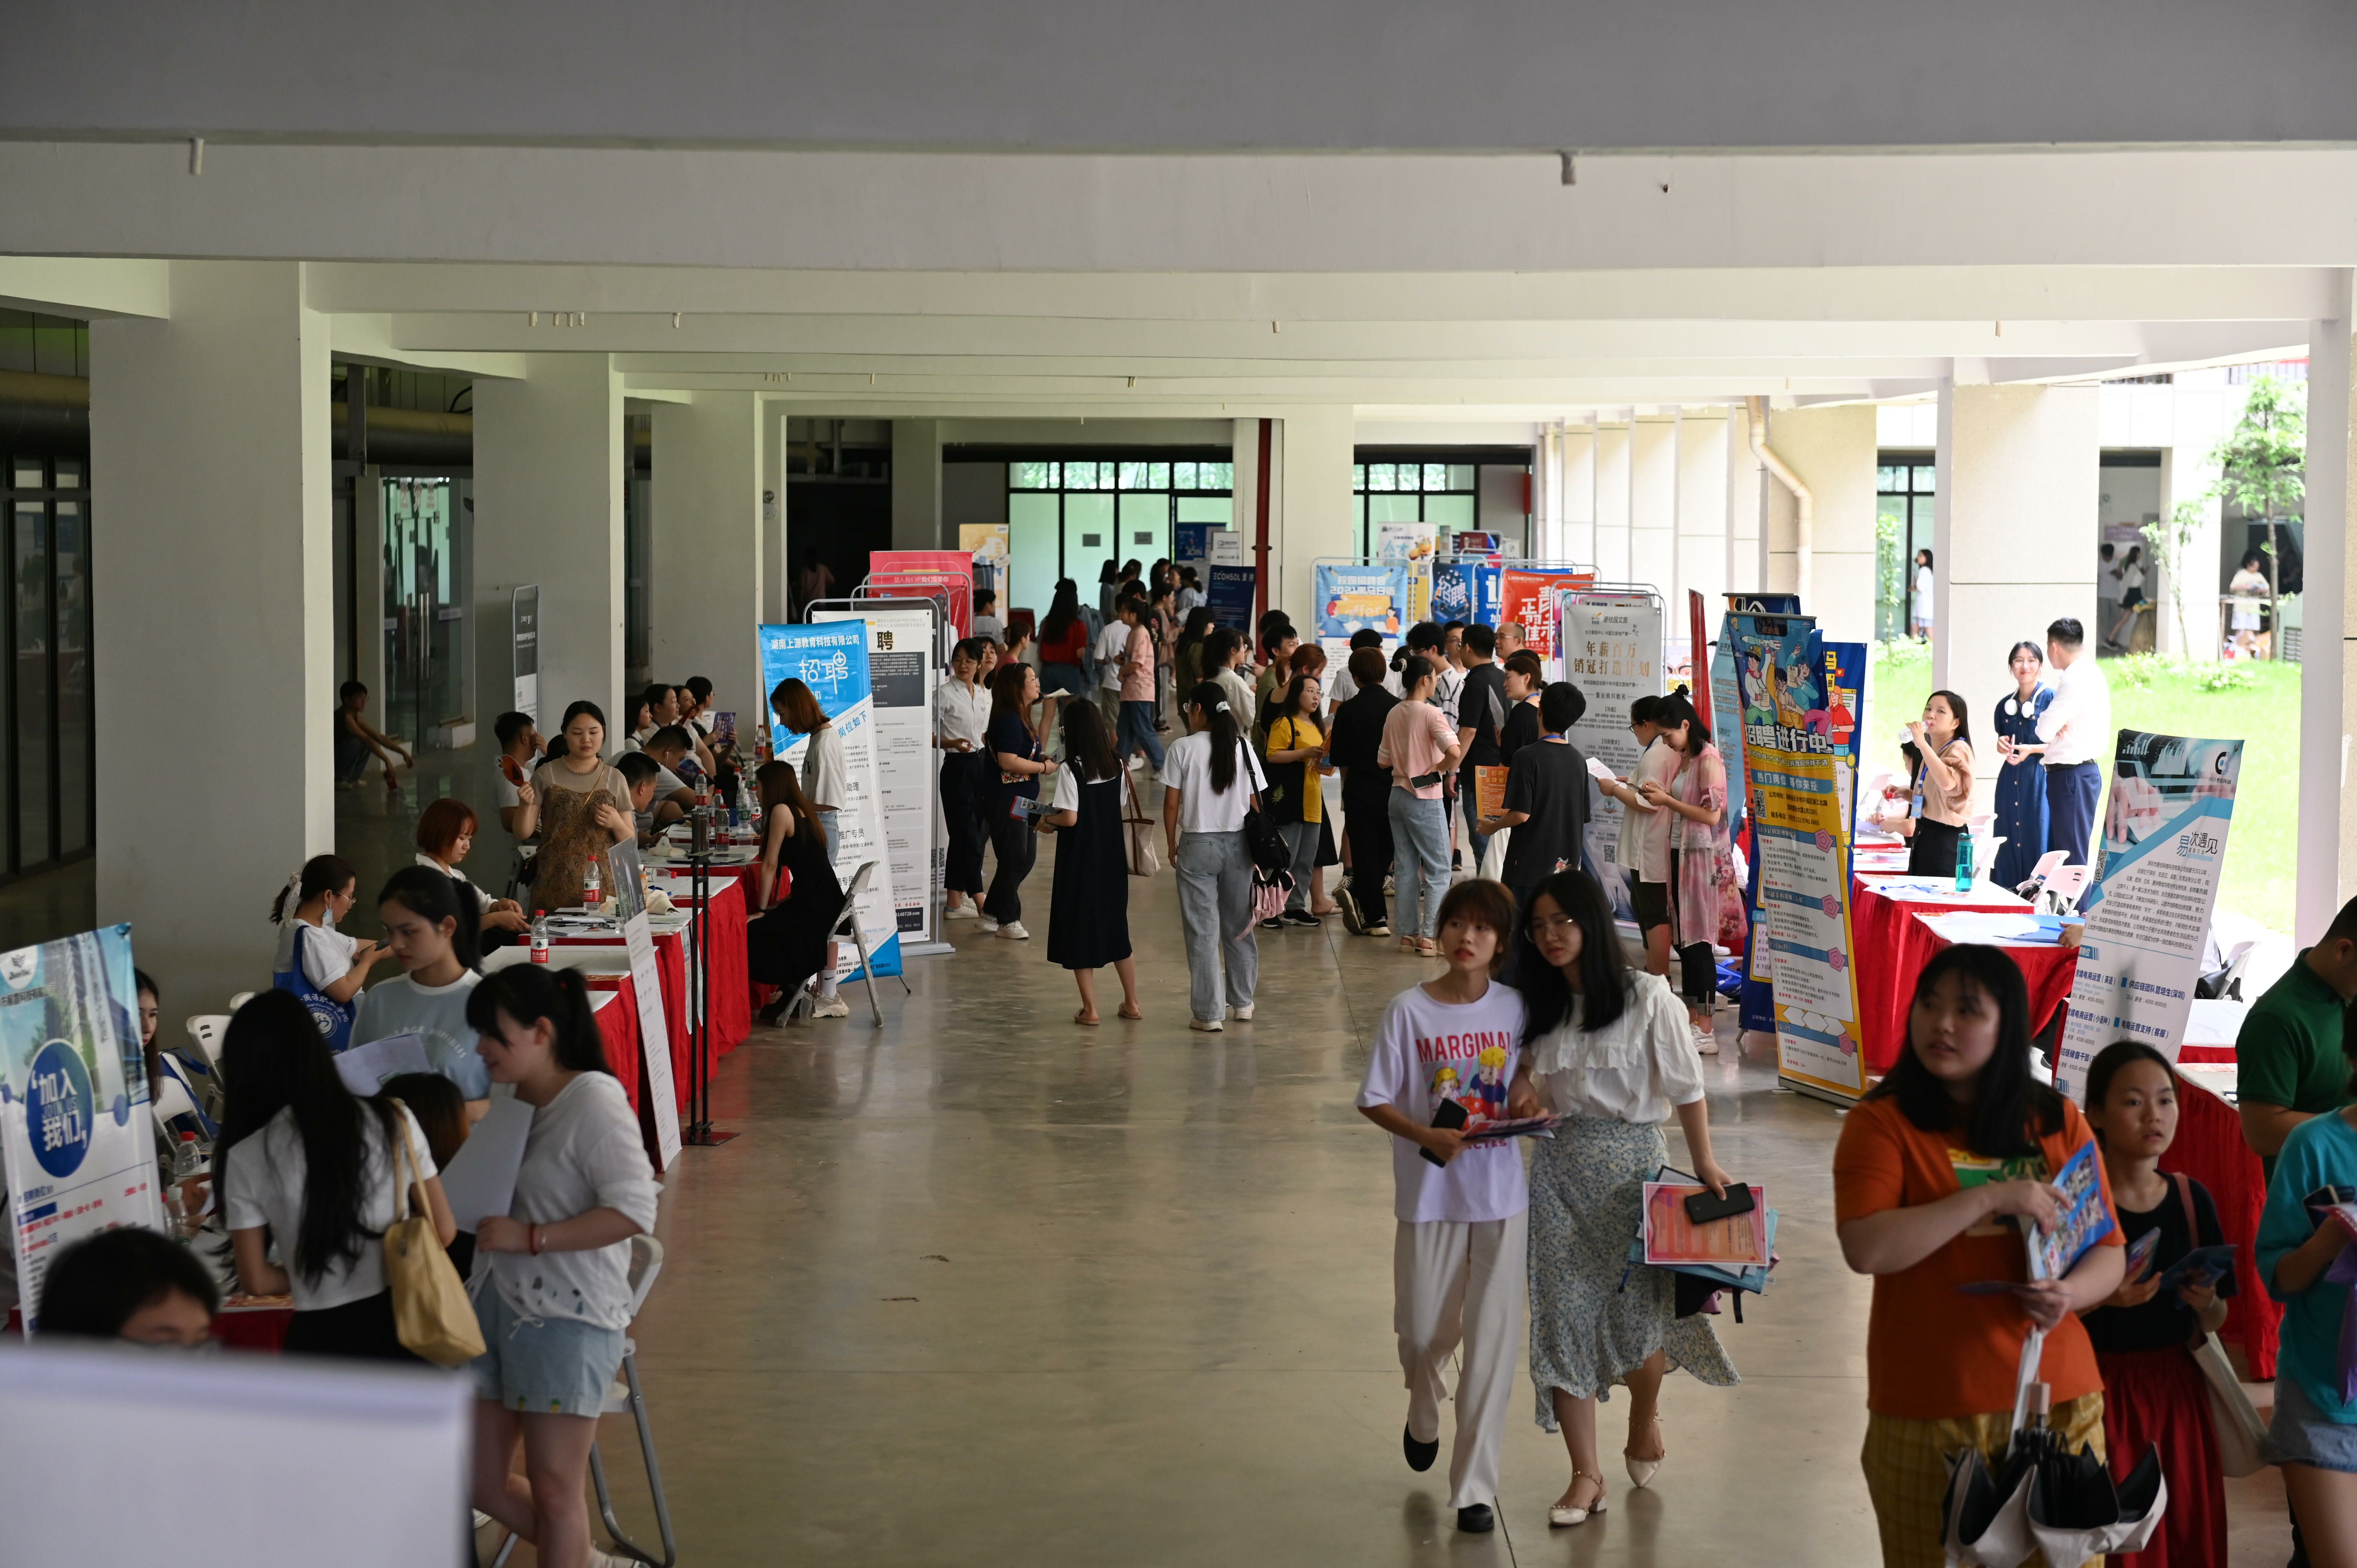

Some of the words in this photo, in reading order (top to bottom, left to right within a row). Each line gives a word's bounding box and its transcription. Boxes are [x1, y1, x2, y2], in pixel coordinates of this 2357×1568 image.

[1338, 576, 1385, 586] 校园招聘会
[1437, 577, 1466, 607] 招聘
[1345, 604, 1383, 617] offer
[771, 634, 860, 650] 湖南上源教育科技有限公司
[876, 630, 893, 650] 聘
[1586, 640, 1636, 659] 年薪百万
[799, 649, 849, 694] 招聘
[1574, 658, 1650, 678] 销冠打造计划
[837, 710, 868, 739] 岗位如下
[1744, 723, 1828, 754] 招聘进行中
[846, 782, 860, 792] 助理
[1757, 772, 1786, 786] 热门岗位
[1790, 777, 1818, 791] 等你来投
[839, 828, 865, 841] 推广专员
[66, 1101, 77, 1112] US
